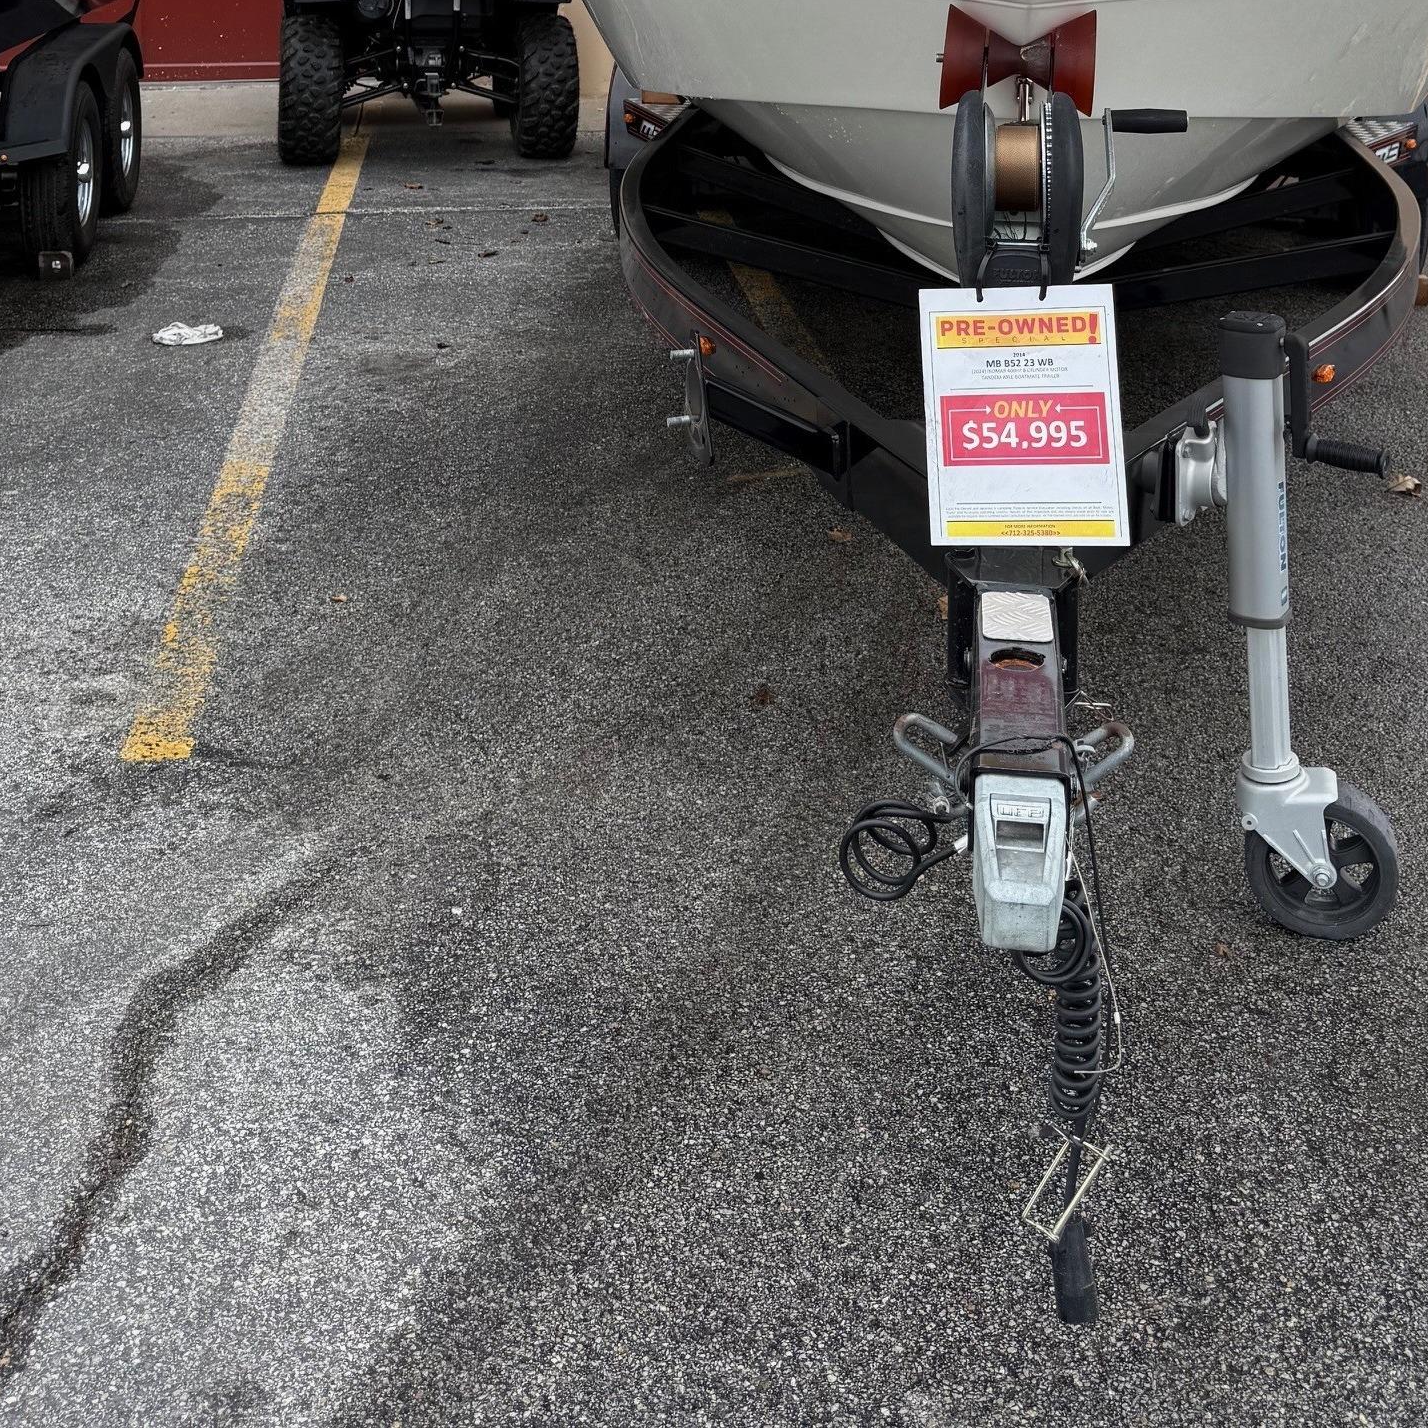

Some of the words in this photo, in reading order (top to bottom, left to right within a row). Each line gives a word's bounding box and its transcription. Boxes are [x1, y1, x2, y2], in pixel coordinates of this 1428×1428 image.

[940, 313, 1098, 345] PRE-OWNED!
[986, 359, 1002, 368] MB
[1004, 359, 1021, 368] B52
[1024, 358, 1035, 367] 23
[1037, 358, 1054, 367] WB
[993, 399, 1053, 419] ONLY
[961, 419, 1088, 451] $54,995
